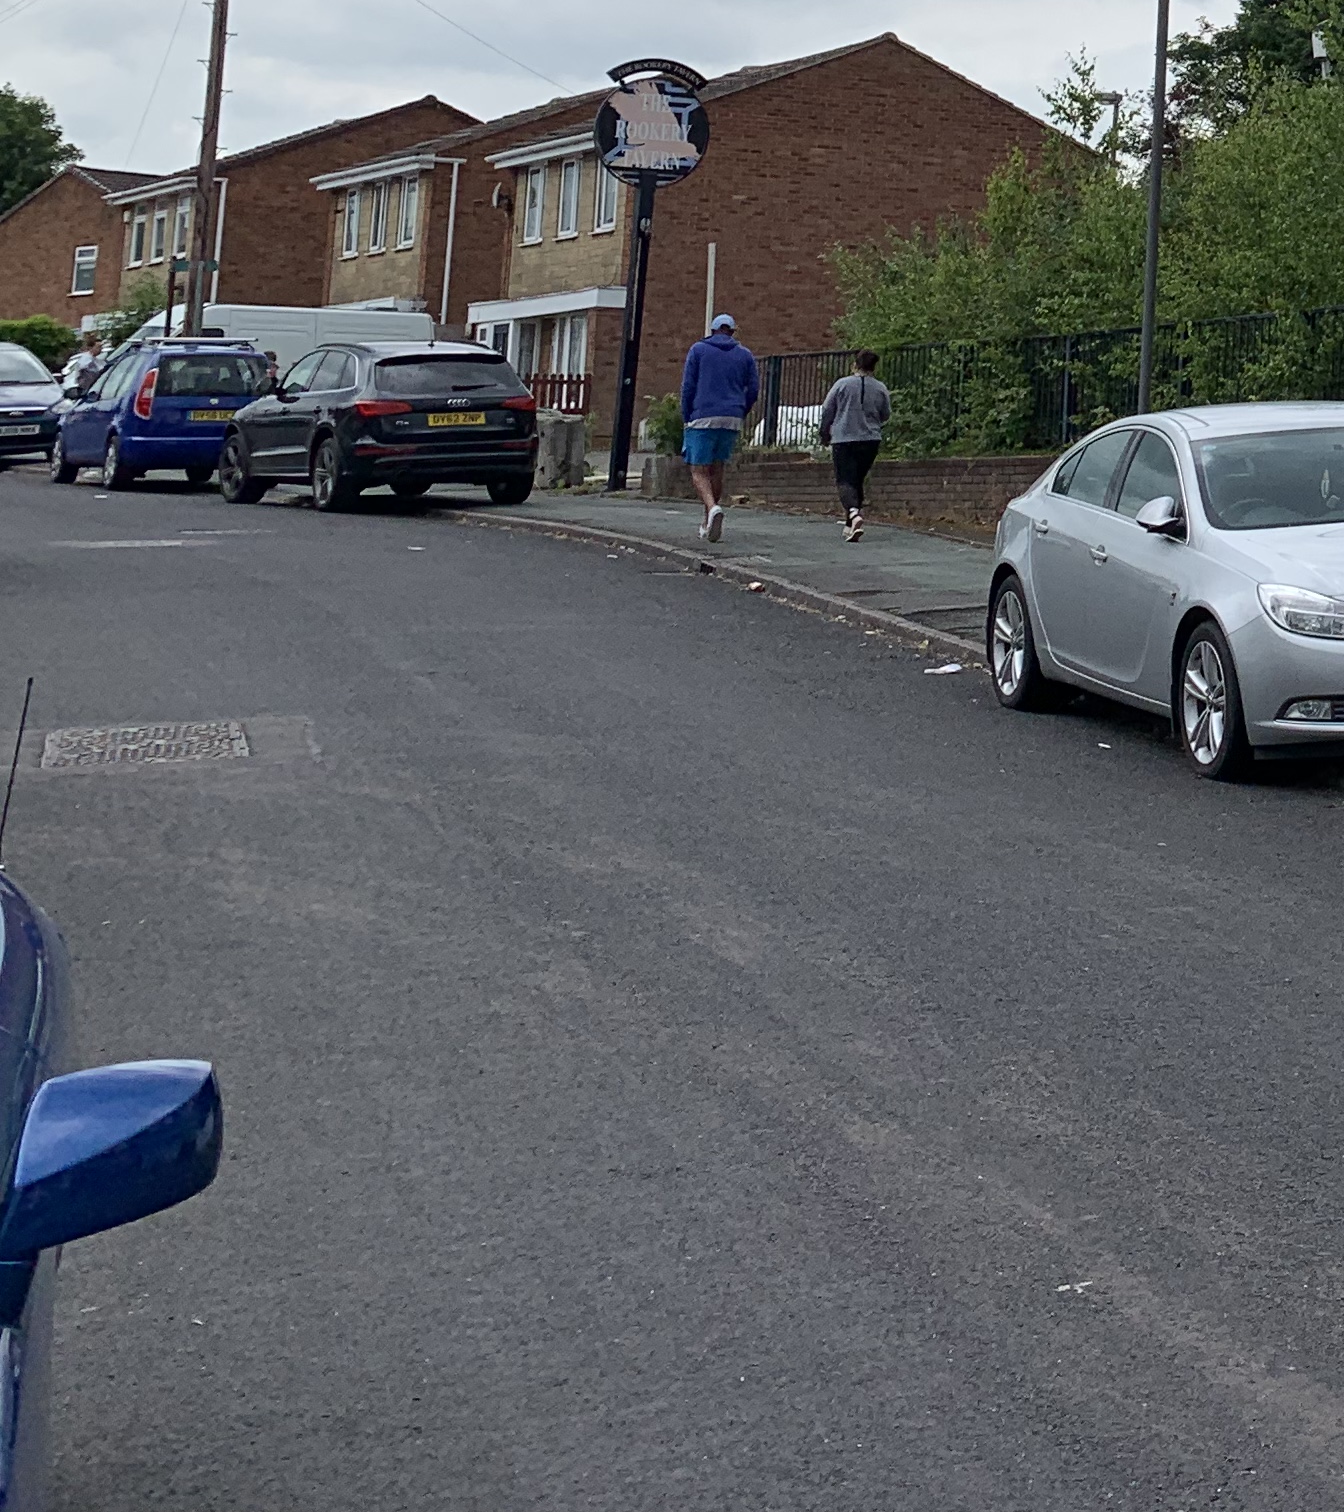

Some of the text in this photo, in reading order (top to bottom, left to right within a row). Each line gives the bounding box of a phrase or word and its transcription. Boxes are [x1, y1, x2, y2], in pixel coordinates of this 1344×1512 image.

[640, 93, 672, 113] THE
[615, 119, 693, 142] ROOKERY
[623, 148, 681, 170] TAVERN
